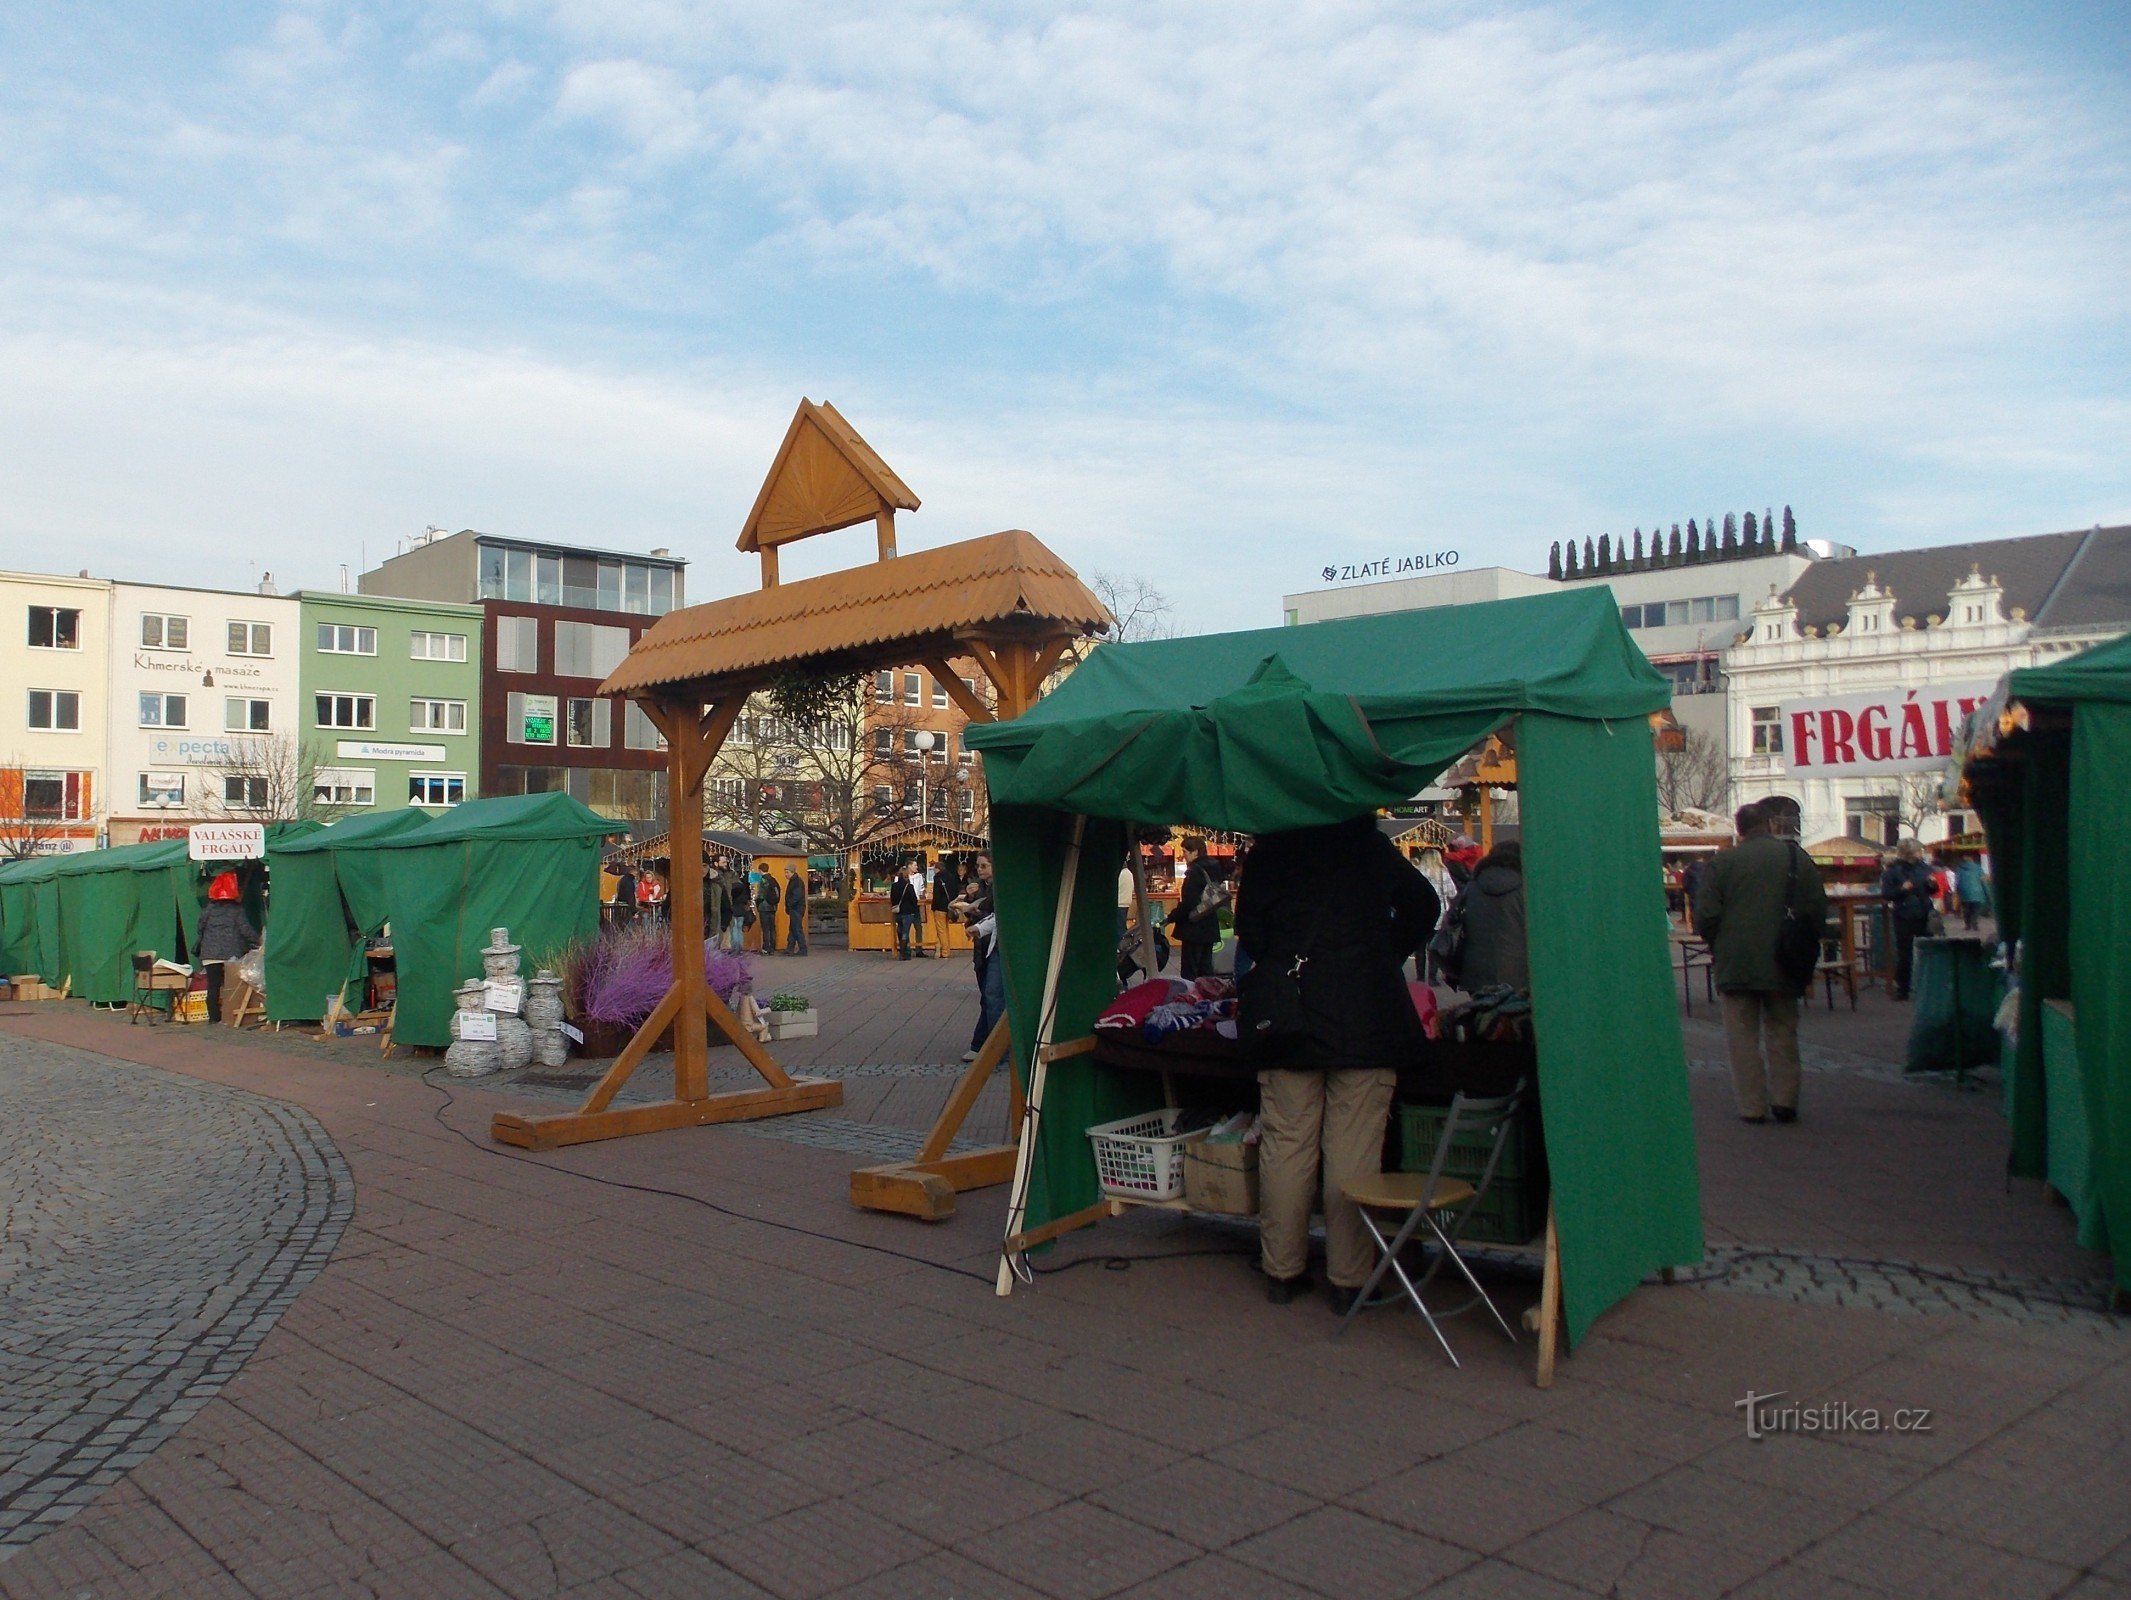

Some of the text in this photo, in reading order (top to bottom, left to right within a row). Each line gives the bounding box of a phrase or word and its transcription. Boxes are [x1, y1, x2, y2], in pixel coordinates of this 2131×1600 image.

[1341, 550, 1459, 580] ZLATÉ JABLKO
[134, 653, 260, 677] Khmerské masáže
[1790, 690, 1987, 767] FRGÁL
[157, 740, 230, 755] expecta
[194, 829, 262, 841] VALAŠSKÉ
[201, 842, 254, 854] FRGÁLY
